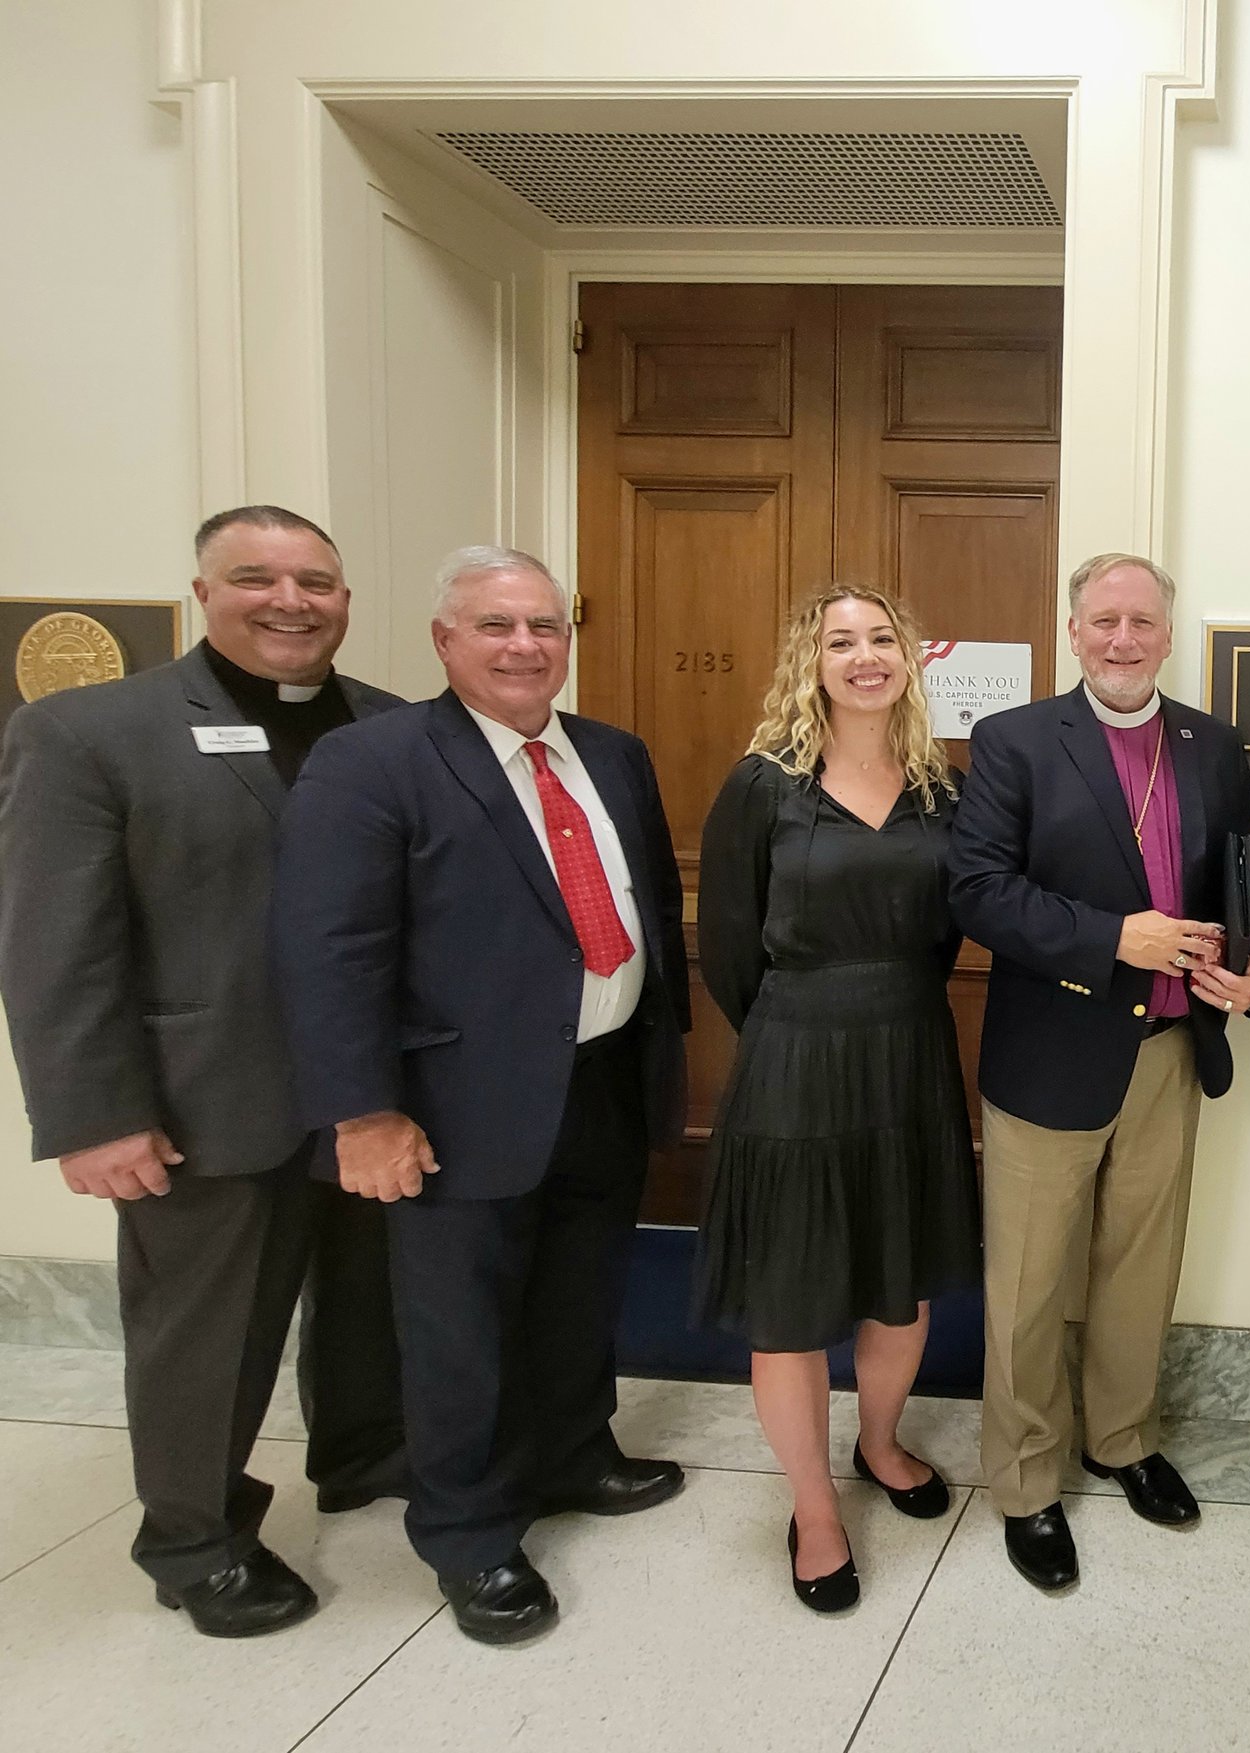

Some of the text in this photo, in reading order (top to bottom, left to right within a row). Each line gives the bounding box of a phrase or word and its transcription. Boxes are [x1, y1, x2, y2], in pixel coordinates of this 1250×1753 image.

[44, 620, 64, 634] OF
[675, 652, 734, 673] 2185
[924, 674, 1020, 689] HANK YOU
[945, 691, 979, 700] CAPITOL
[981, 692, 1011, 701] POLICE
